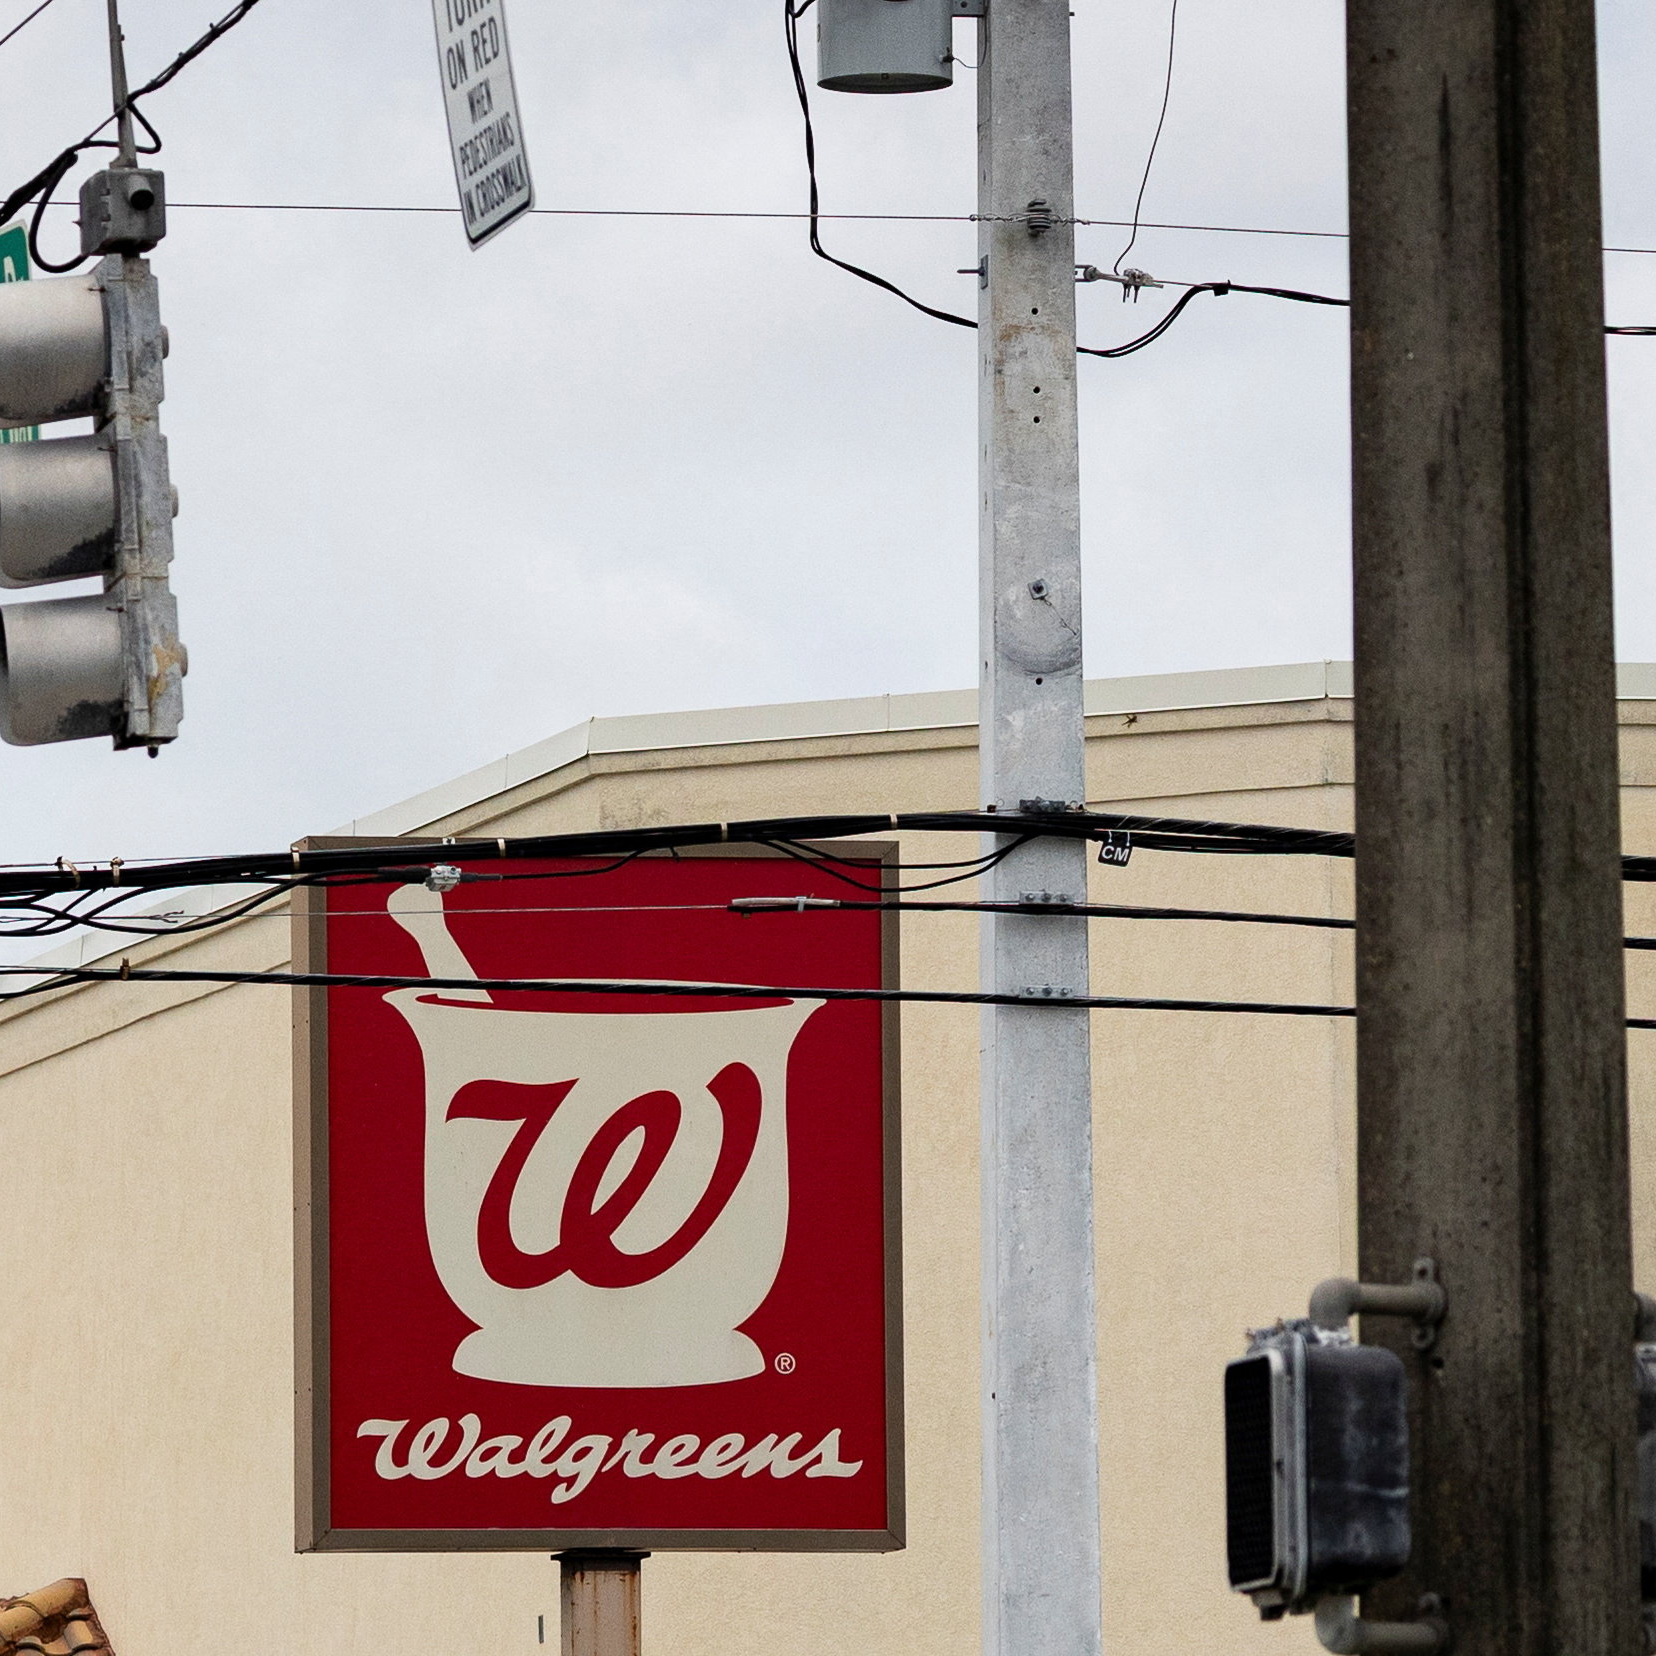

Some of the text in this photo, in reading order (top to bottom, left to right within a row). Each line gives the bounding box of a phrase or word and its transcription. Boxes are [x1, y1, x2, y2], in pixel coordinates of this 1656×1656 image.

[445, 0, 491, 32] TU
[446, 16, 500, 90] ON RED
[467, 78, 494, 124] WHEN
[459, 112, 515, 179] PEDESTRIANS
[474, 154, 528, 218] CROSSWALK
[1101, 845, 1130, 862] CM
[356, 1412, 864, 1505] Walgreens
